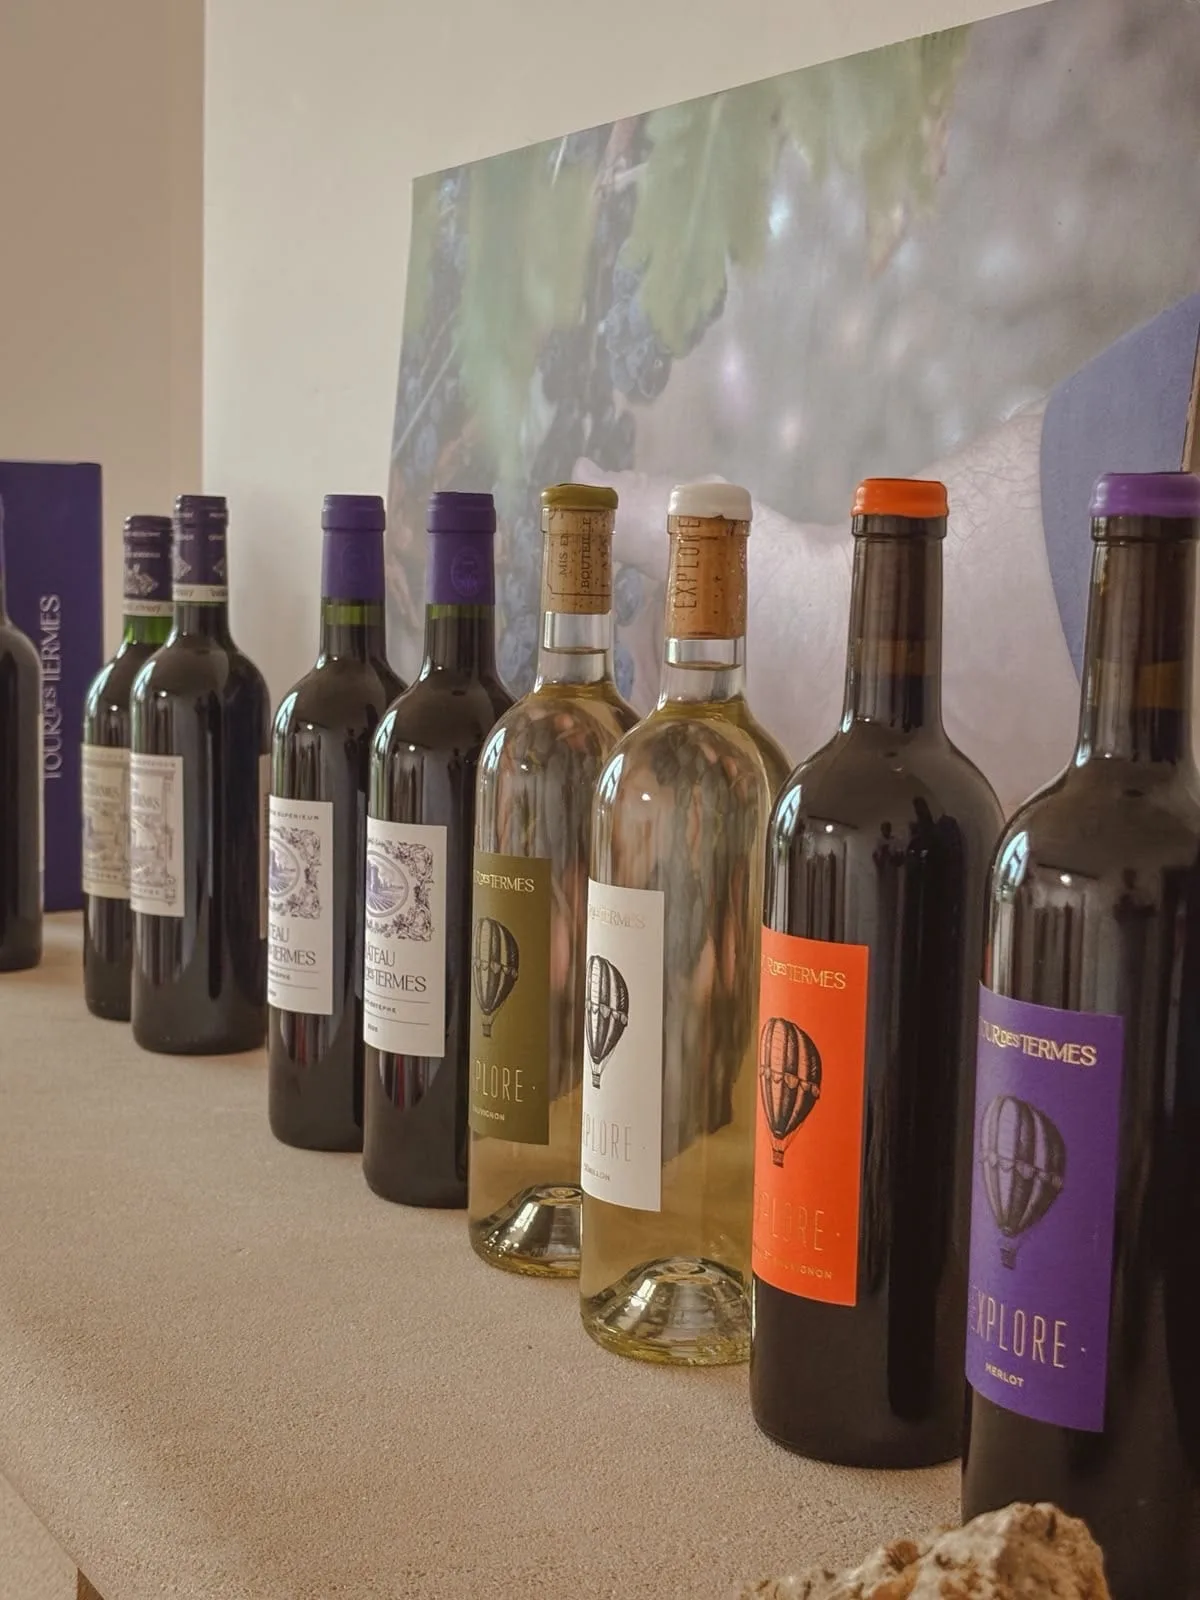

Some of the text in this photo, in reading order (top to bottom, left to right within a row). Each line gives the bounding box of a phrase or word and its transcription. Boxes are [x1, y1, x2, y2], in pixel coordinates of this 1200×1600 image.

[39, 594, 61, 681] TERMES
[490, 873, 535, 892] TERMES
[375, 967, 427, 993] TERMES
[786, 963, 846, 990] TERMES
[1020, 1034, 1097, 1067] TERMES
[985, 1362, 1025, 1388] MERLOT
